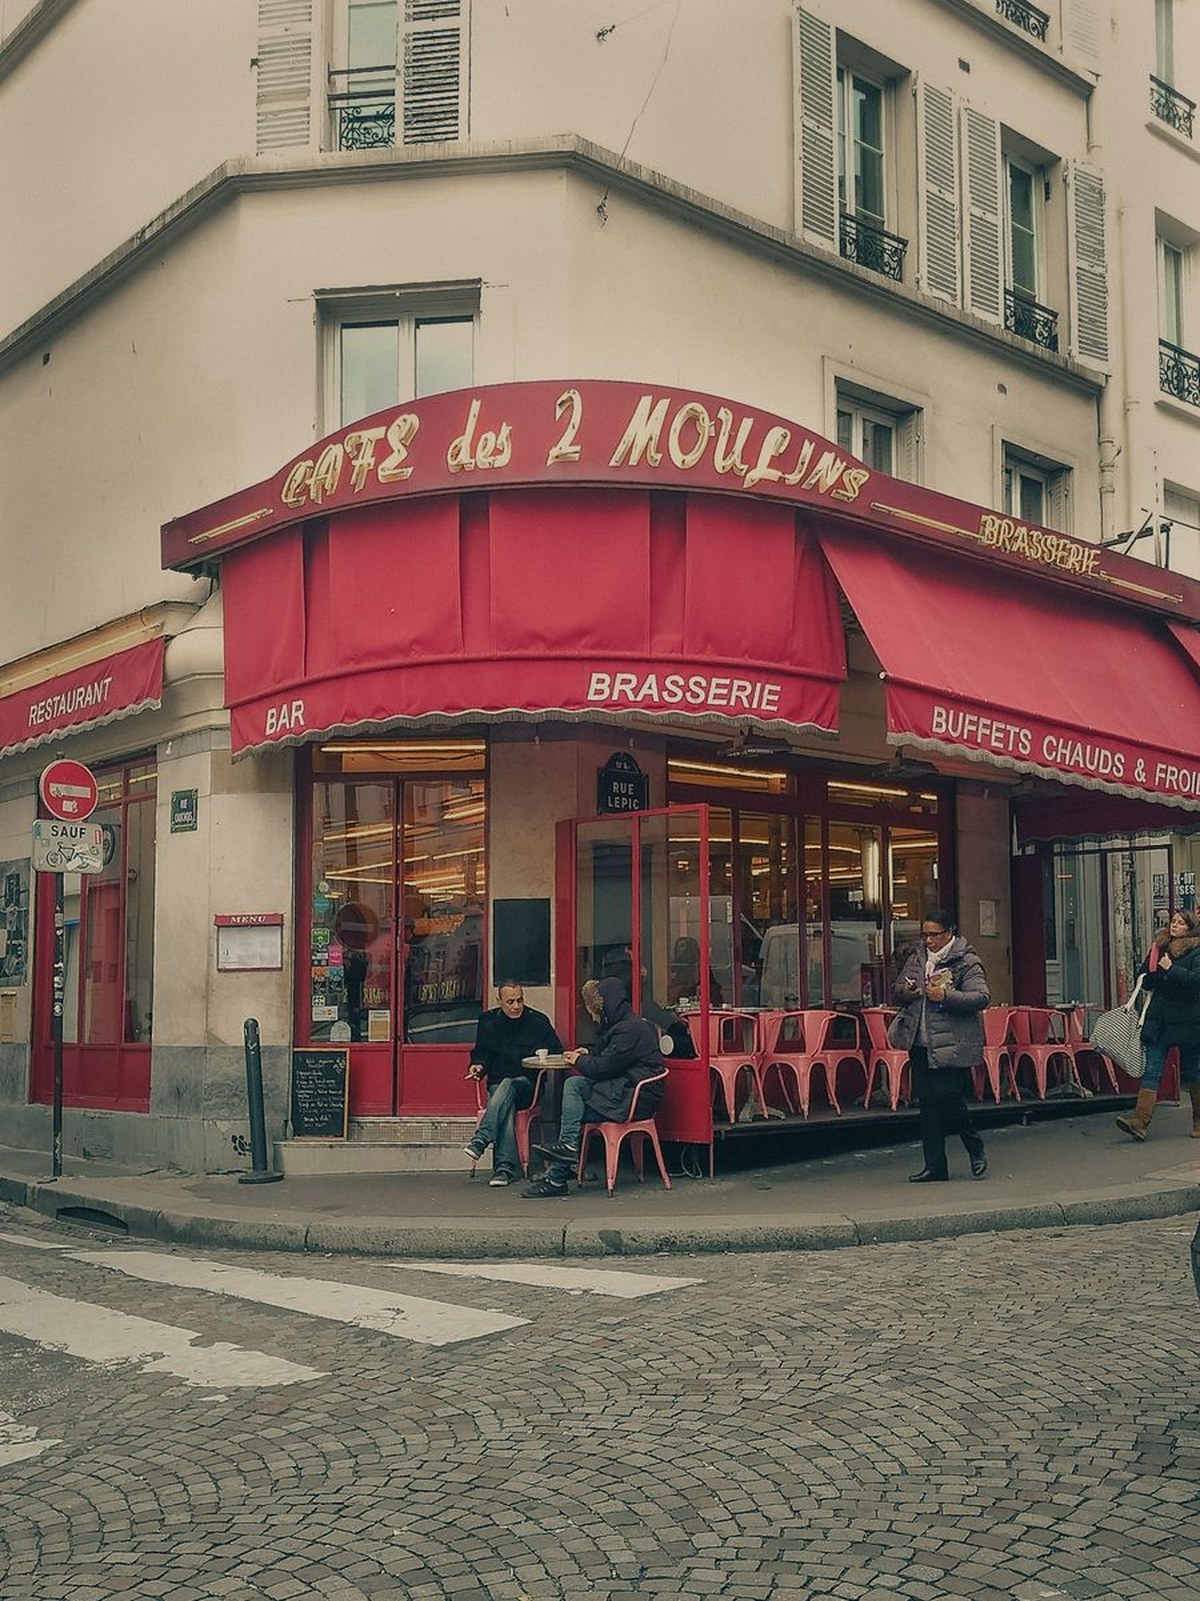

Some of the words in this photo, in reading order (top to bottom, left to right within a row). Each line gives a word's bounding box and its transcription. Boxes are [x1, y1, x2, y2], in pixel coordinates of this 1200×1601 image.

[447, 397, 512, 473] des
[545, 388, 583, 468] 2
[608, 395, 869, 502] MOULINS
[980, 513, 1102, 578] BRASSERIE
[28, 676, 112, 727] RESTAURANT
[586, 671, 782, 712] BRASSERIE
[264, 700, 305, 736] BAR
[931, 705, 1032, 755] BUFFETS
[1042, 735, 1125, 778] CHAUDS
[1134, 758, 1146, 783] &
[608, 795, 640, 810] LEPIC
[612, 781, 634, 795] RUE
[51, 825, 86, 839] SAUF
[230, 916, 267, 924] MENU
